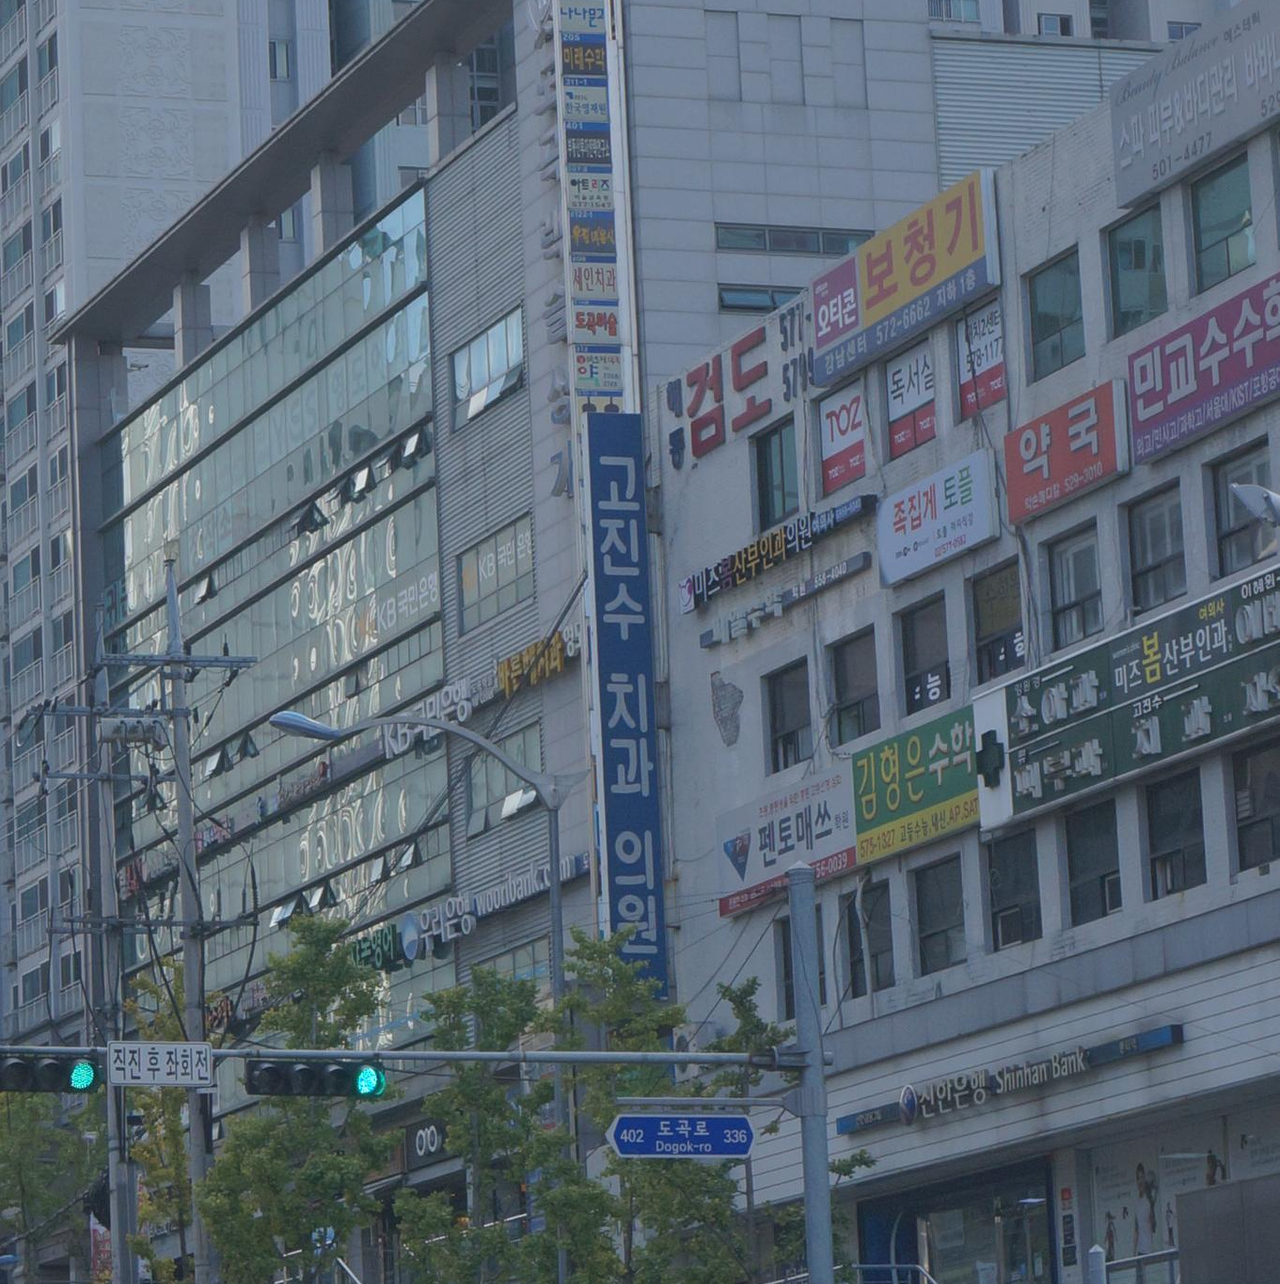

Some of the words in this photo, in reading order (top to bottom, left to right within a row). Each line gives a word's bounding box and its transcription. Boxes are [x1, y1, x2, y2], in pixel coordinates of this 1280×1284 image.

[866, 182, 979, 310] 보청기
[573, 267, 617, 292] 세인치과
[817, 287, 857, 338] 오티콘
[824, 335, 868, 376] 강남센터
[875, 296, 932, 345] 572-6662
[686, 325, 773, 459] 검도
[826, 395, 863, 443] TOZ
[1019, 397, 1100, 480] 약국
[892, 482, 938, 536] 족집게
[943, 465, 973, 512] 토플
[597, 455, 646, 642] 고진수
[1114, 619, 1228, 694] 미즈봄산부인과
[606, 672, 654, 798] 치과
[1132, 695, 1163, 719] 고진수
[757, 799, 833, 868] 펜토매쓰
[811, 851, 849, 879] 56-0039
[476, 856, 573, 917] wooribank.cm
[613, 828, 659, 955] 의원
[112, 1047, 142, 1081] 직진
[146, 1049, 161, 1080] 후
[165, 1048, 210, 1083] 좌회전
[919, 1070, 988, 1118] 신한은행
[994, 1061, 1048, 1095] Shinhan
[1052, 1046, 1087, 1081] Bank
[620, 1129, 645, 1144] 402
[655, 1140, 712, 1155] Dogok-ro
[657, 1119, 710, 1139] 도곡로
[722, 1129, 747, 1144] 336
